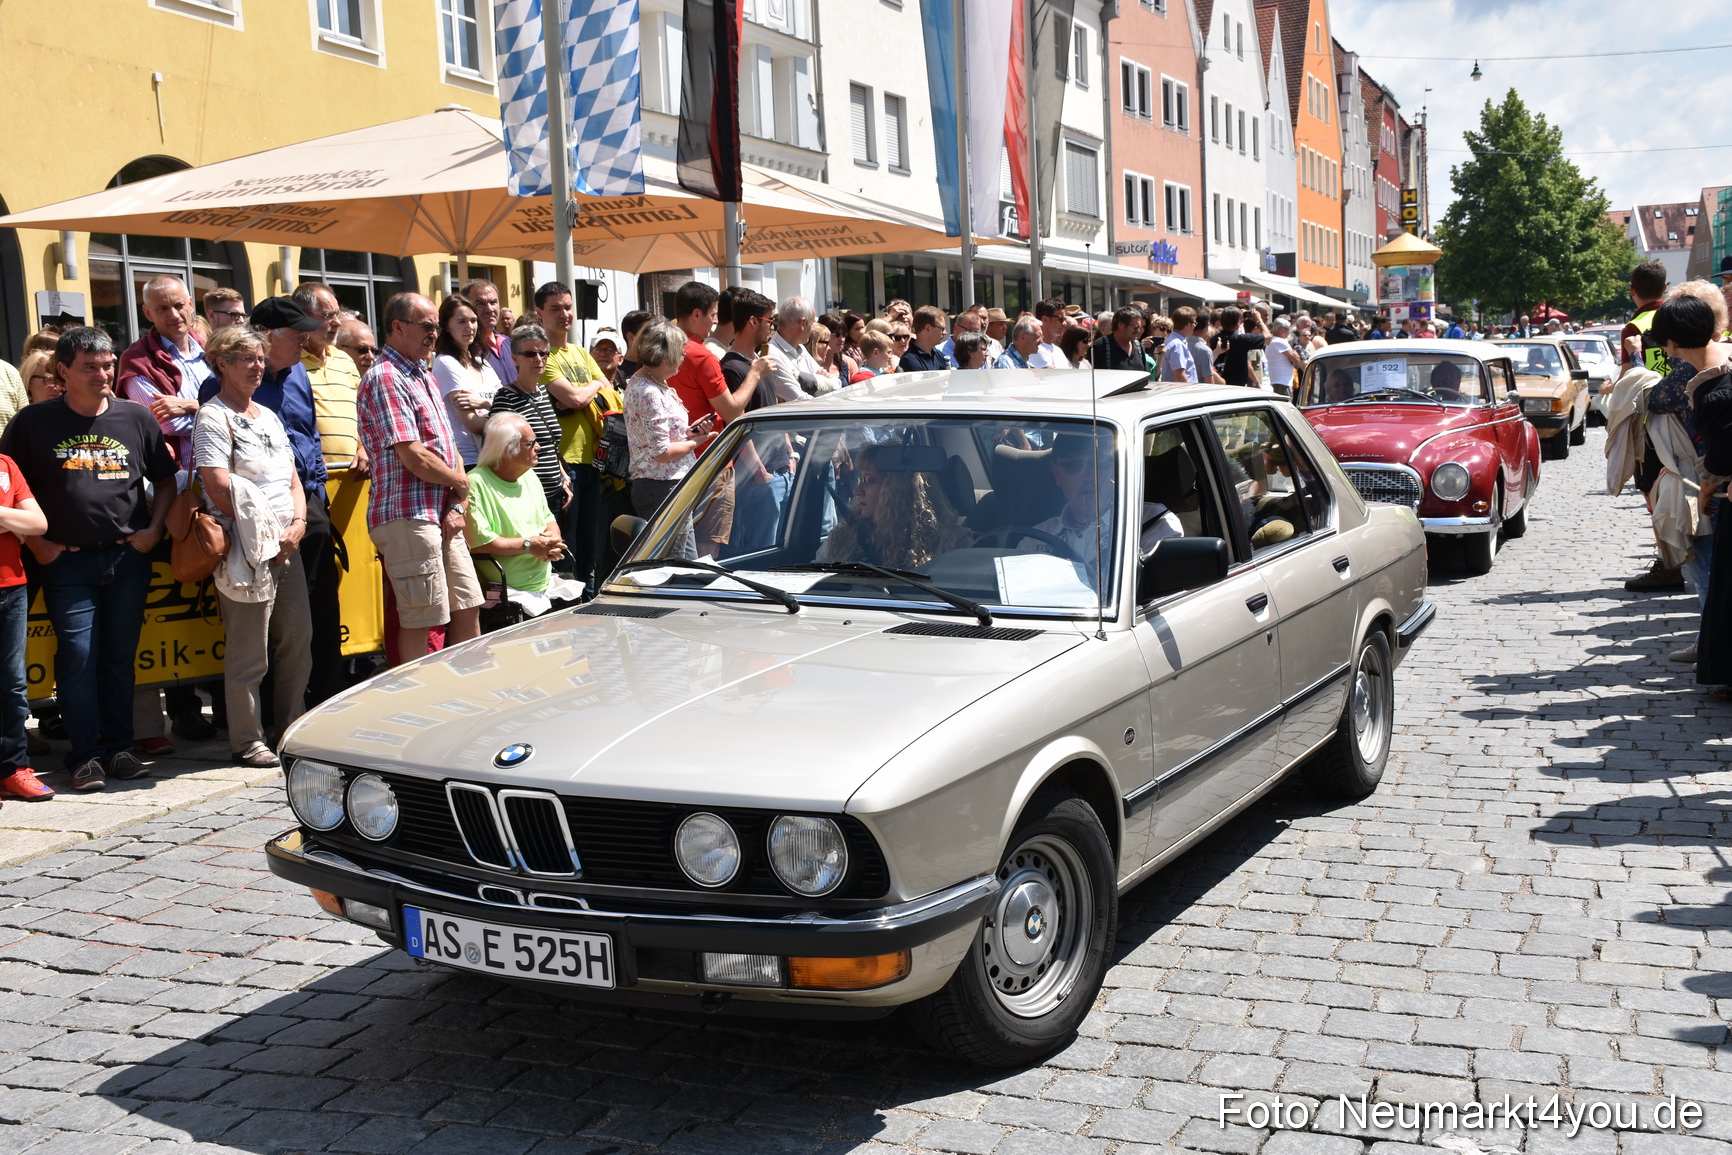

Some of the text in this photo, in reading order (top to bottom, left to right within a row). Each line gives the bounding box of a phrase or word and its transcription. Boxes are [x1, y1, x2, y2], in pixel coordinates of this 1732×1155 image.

[510, 284, 521, 298] 24
[53, 435, 98, 454] AMAZON
[411, 936, 418, 948] D
[425, 917, 610, 981] AS E 525H
